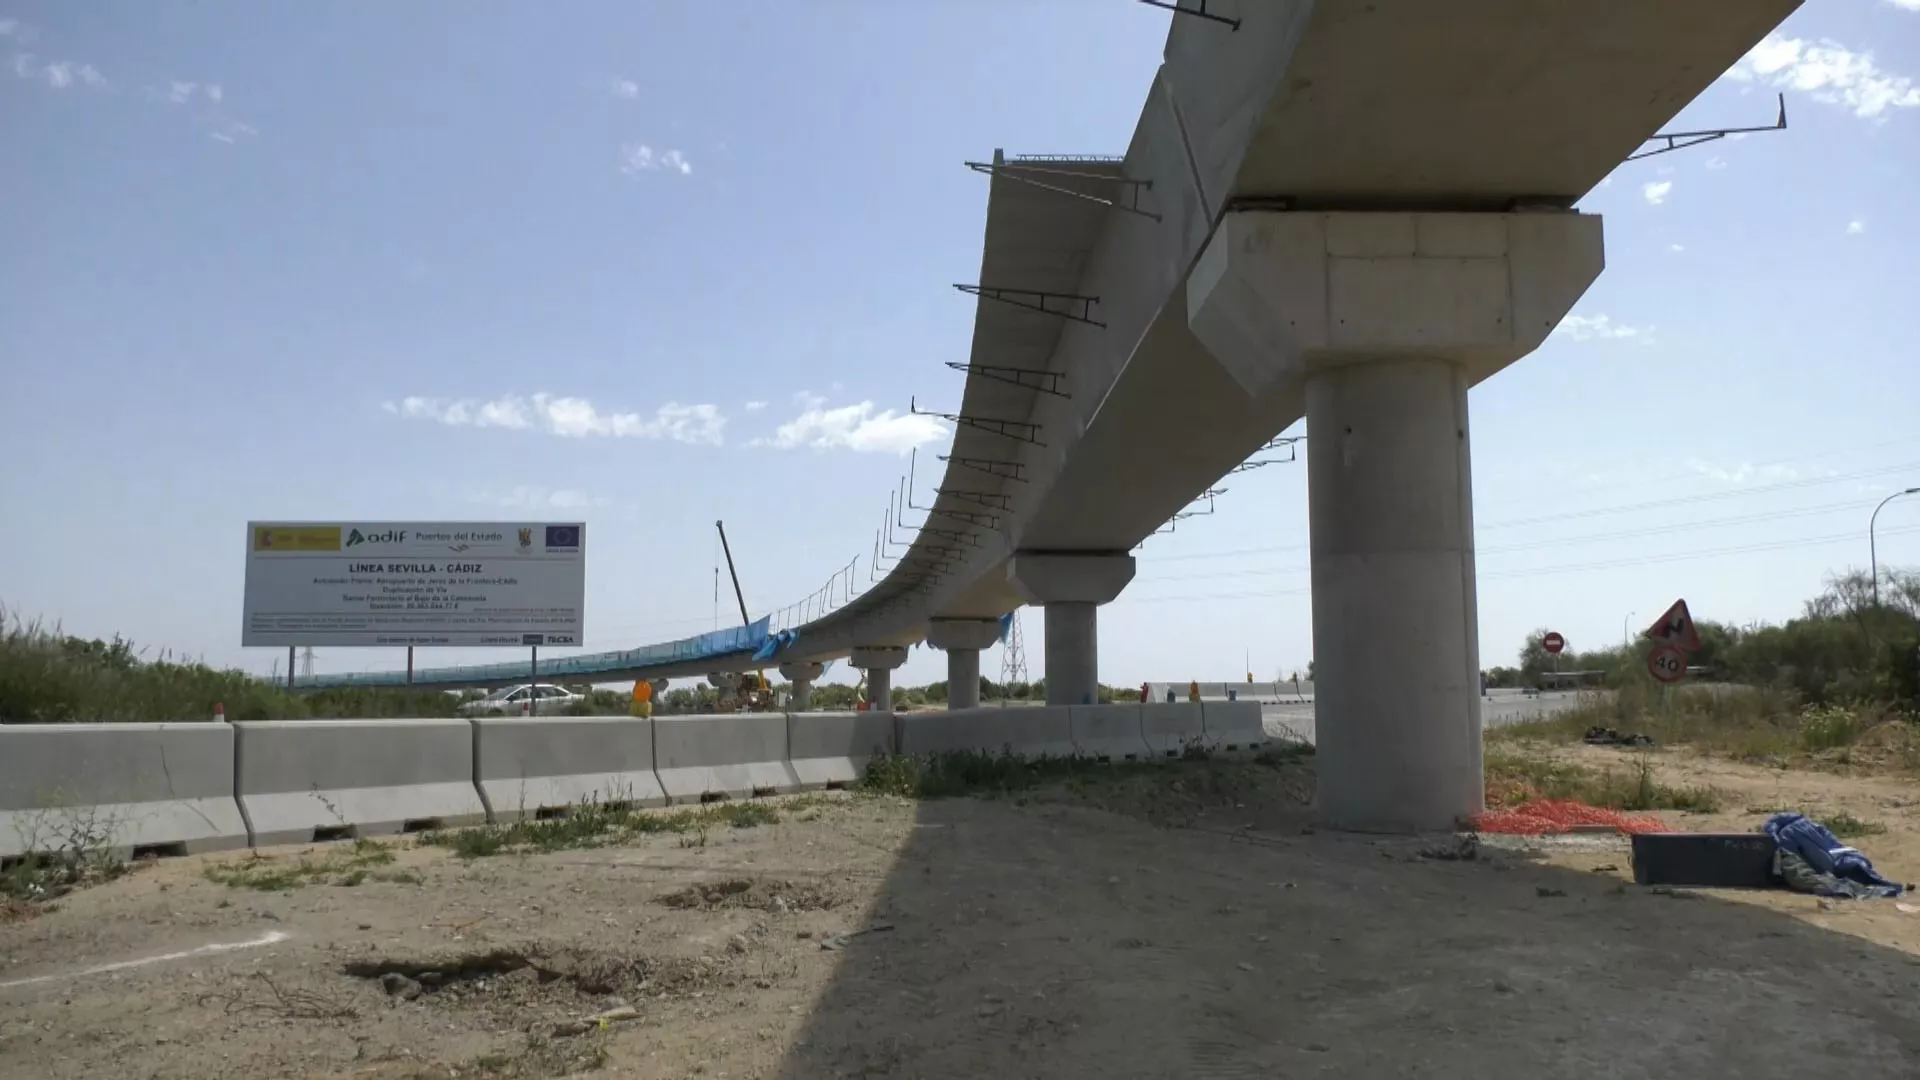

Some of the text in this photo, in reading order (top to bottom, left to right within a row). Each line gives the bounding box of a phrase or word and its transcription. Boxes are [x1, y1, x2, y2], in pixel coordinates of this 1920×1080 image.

[367, 530, 408, 544] adif
[416, 531, 502, 541] Puertos del Estado
[349, 562, 384, 573] LÍNEA
[387, 563, 437, 573] SEVILLA
[446, 562, 483, 573] CÁDIZ
[1655, 656, 1680, 673] 40
